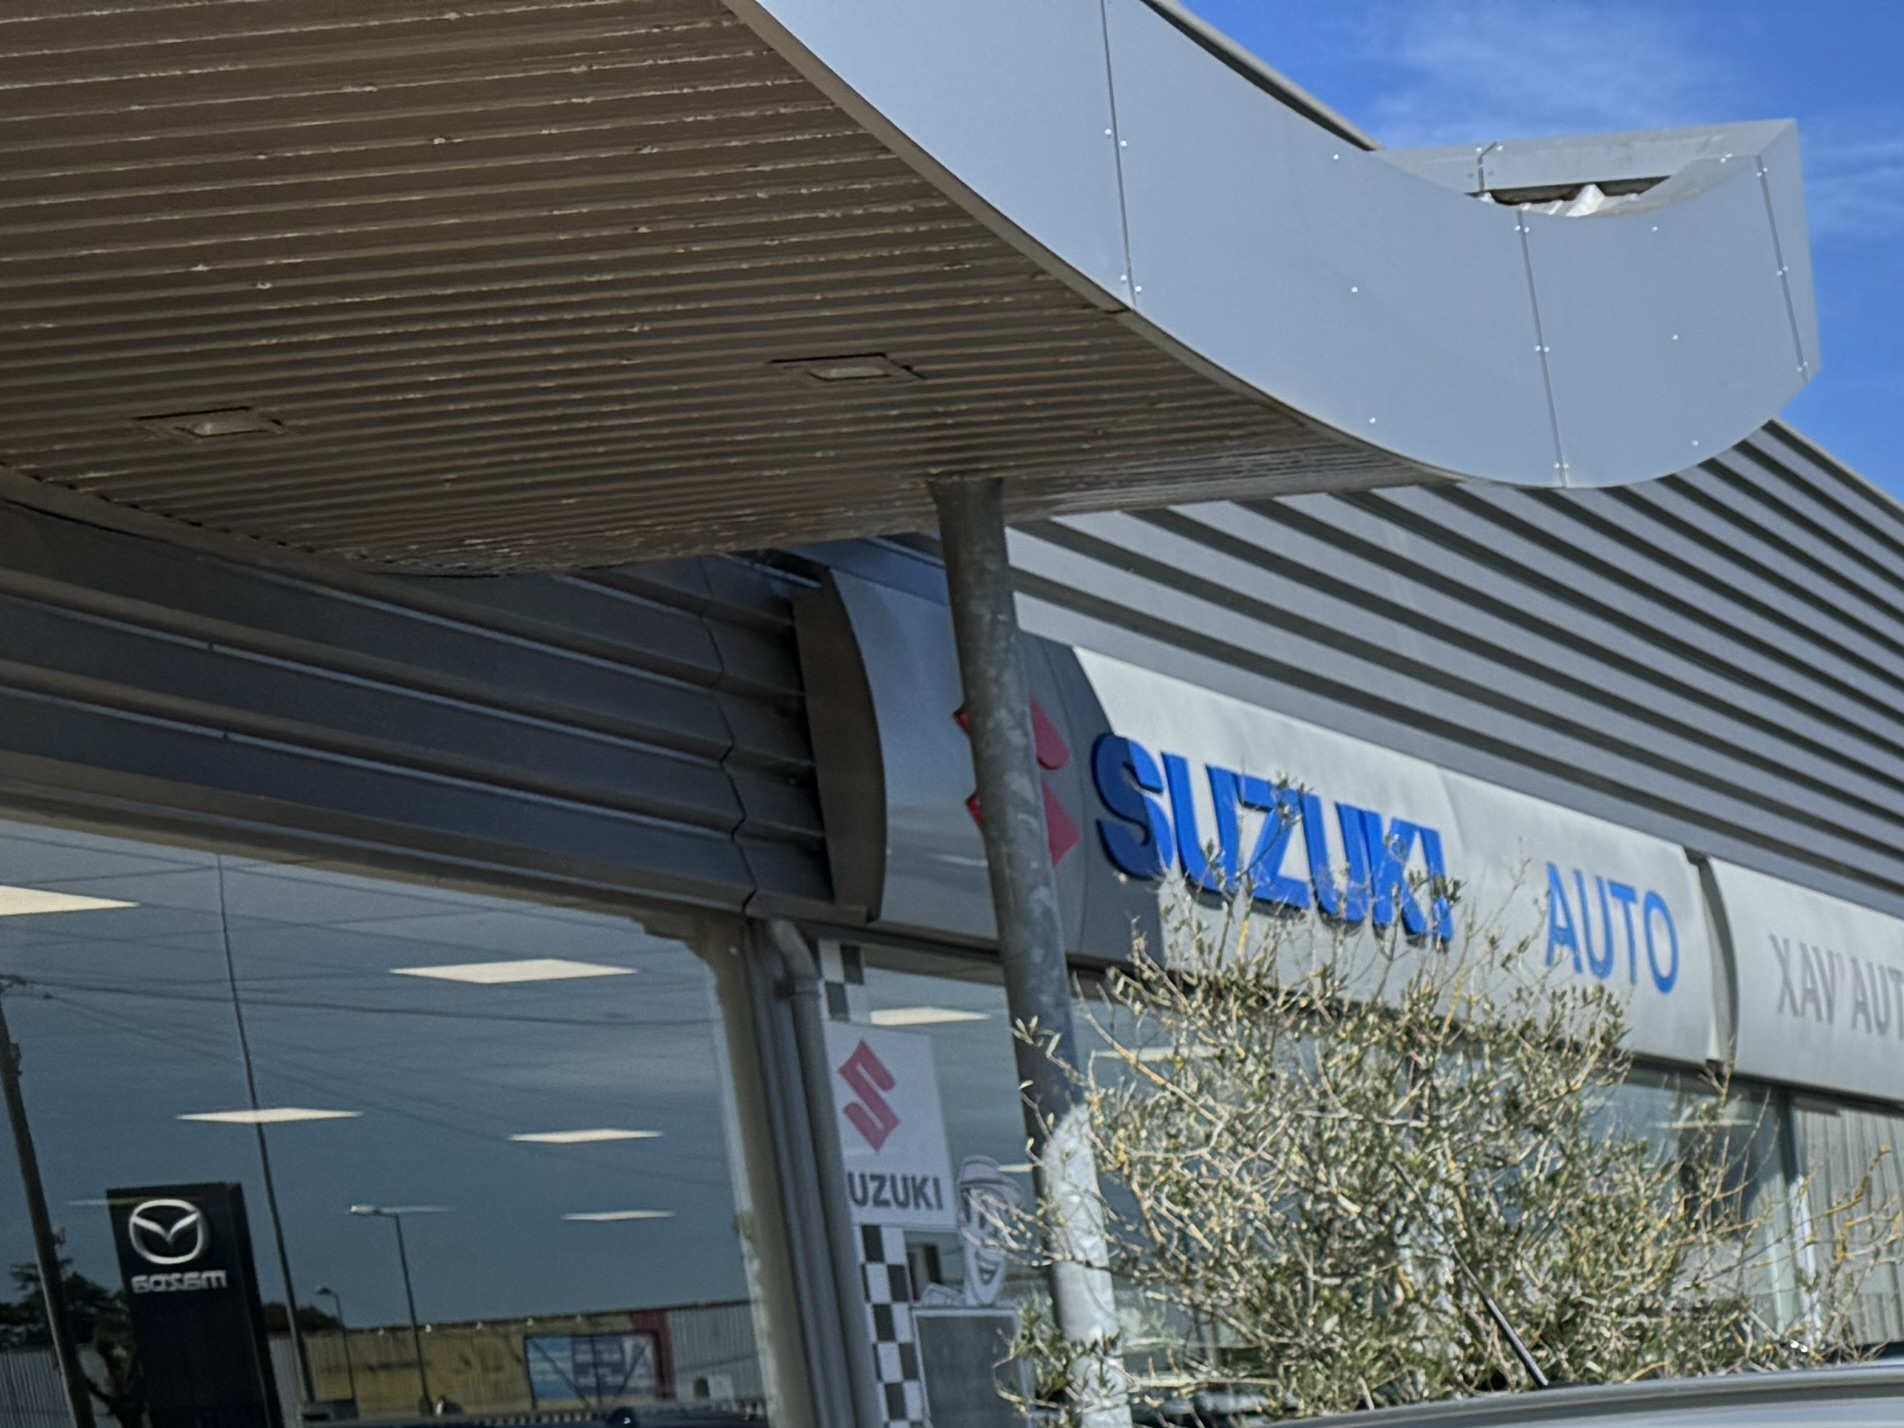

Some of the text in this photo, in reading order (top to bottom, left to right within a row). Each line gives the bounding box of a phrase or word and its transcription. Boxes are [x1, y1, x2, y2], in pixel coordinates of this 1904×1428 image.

[1091, 732, 1454, 942] SUZUKI
[1544, 862, 1680, 995] AUTO
[847, 1170, 943, 1212] UZUKI
